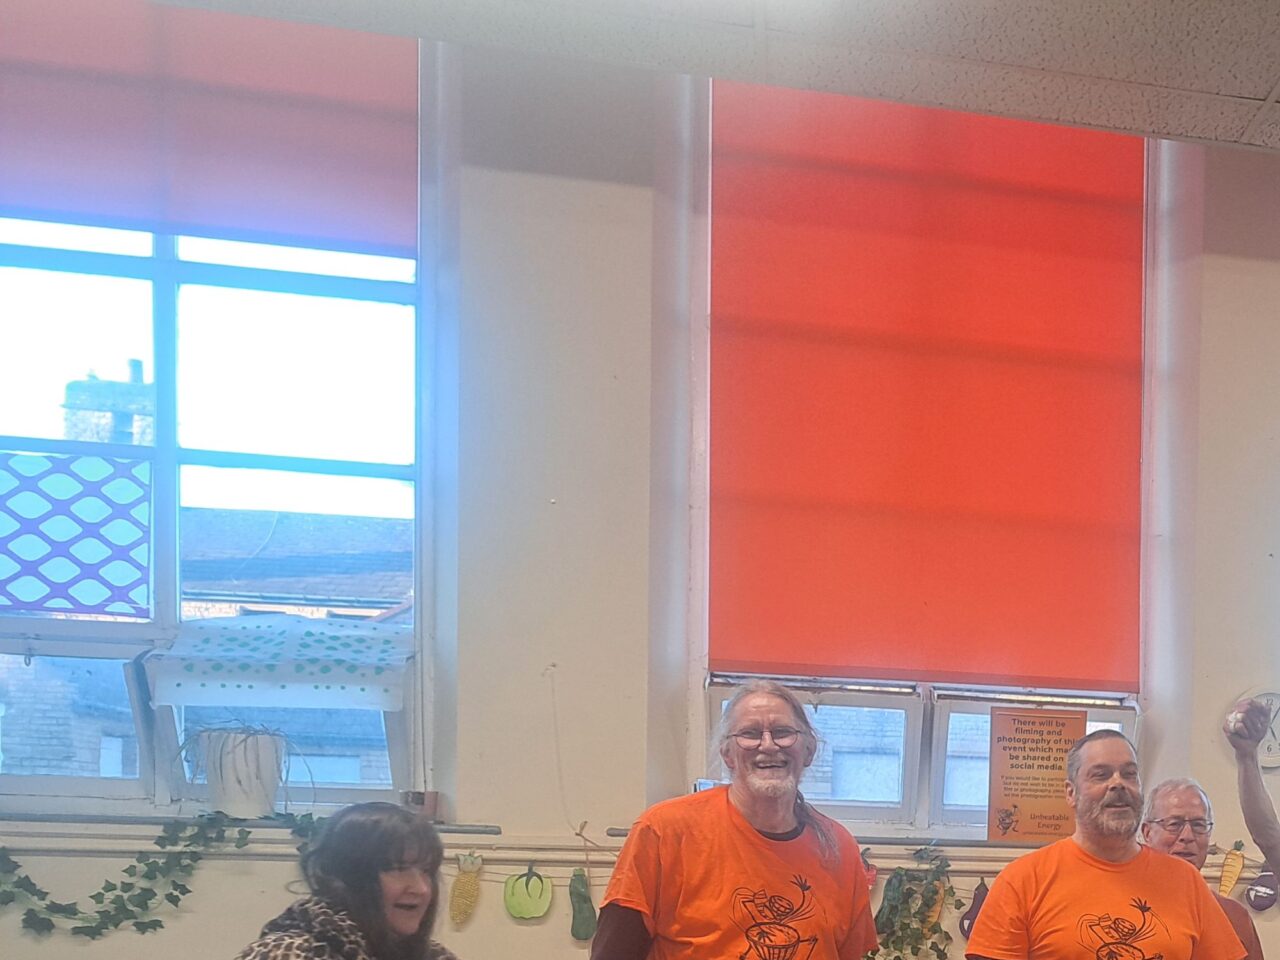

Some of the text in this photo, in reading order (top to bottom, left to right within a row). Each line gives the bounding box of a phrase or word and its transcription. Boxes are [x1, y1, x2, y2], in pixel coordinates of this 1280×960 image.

[1012, 718, 1036, 726] There
[1039, 719, 1053, 727] will
[1015, 727, 1044, 736] filming
[997, 736, 1051, 745] photography
[1053, 737, 1062, 745] of
[1028, 745, 1054, 753] which
[1030, 813, 1069, 821] Unbeatable
[1037, 822, 1062, 830] Energy
